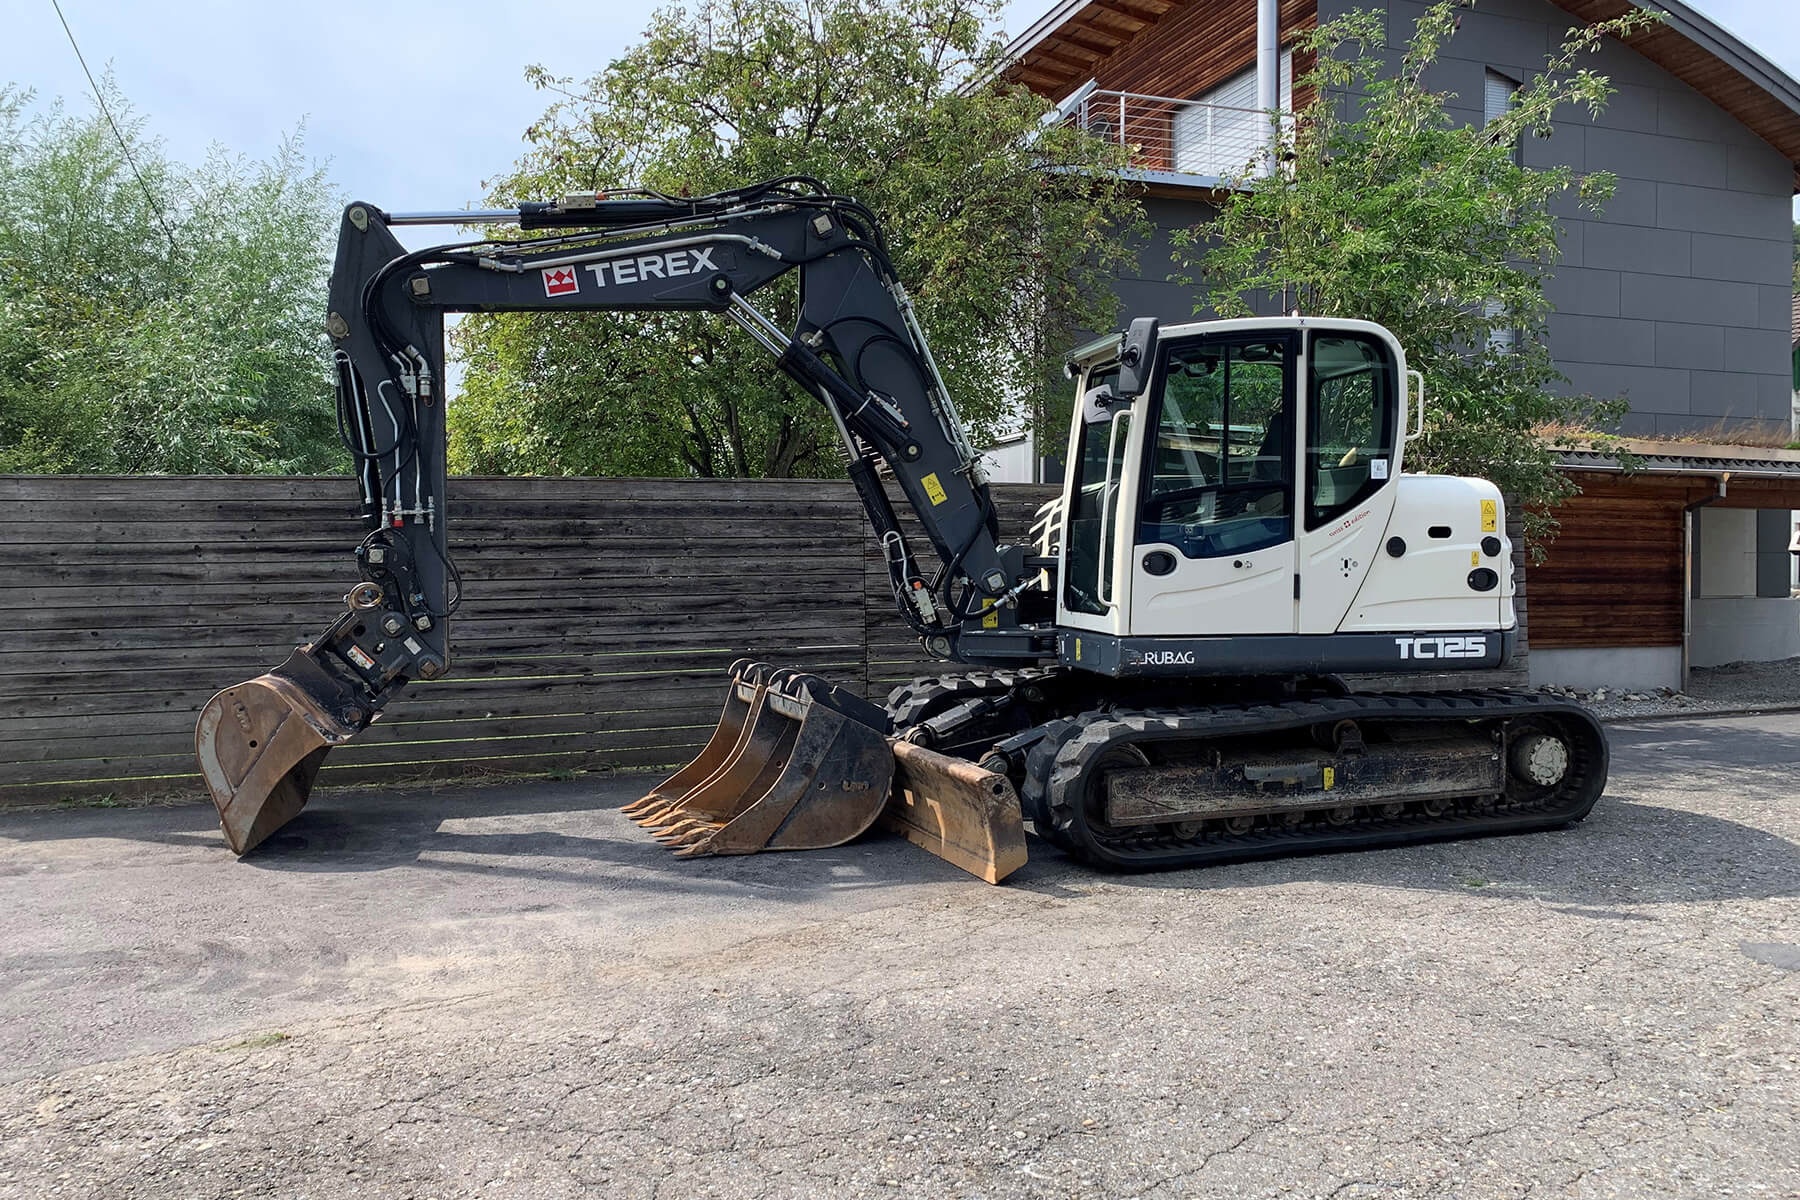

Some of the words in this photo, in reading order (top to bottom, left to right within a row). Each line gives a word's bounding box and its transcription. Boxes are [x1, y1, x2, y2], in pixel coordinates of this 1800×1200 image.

[585, 247, 719, 287] TEREX
[1328, 526, 1344, 537] swiss
[1351, 510, 1371, 524] edition
[1144, 651, 1195, 665] RUBAG
[1395, 637, 1486, 659] TC125
